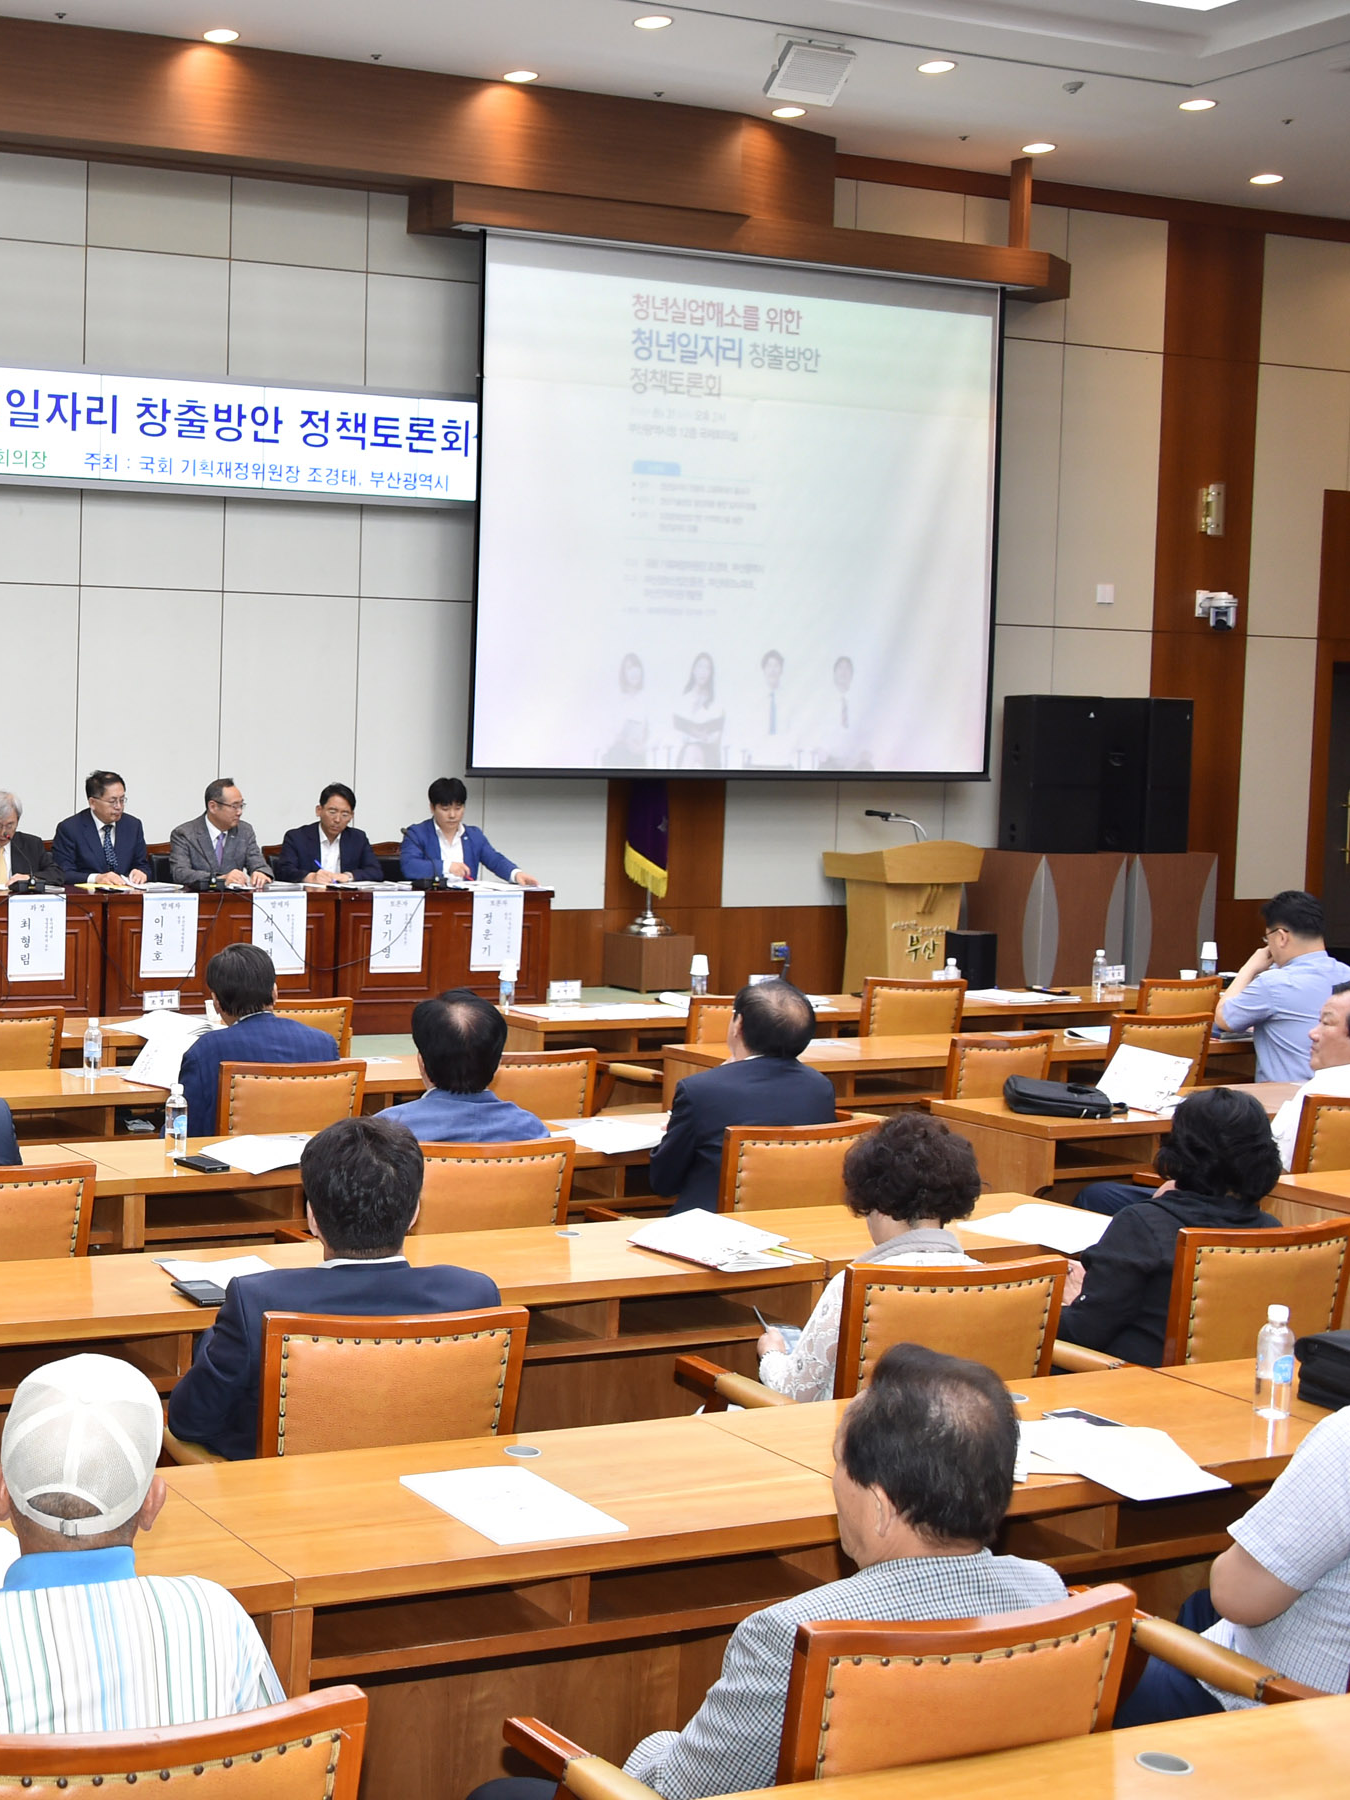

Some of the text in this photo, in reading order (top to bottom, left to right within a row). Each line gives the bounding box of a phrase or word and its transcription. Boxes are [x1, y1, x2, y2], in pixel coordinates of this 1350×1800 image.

[631, 293, 803, 336] 청년실업해소를 위한
[631, 327, 821, 374] 청년일자리 창출방안
[630, 367, 723, 399] 정책토론회
[136, 397, 283, 444] 창출방안
[299, 408, 470, 457] 정책토론회
[84, 453, 119, 472] 주최
[139, 456, 173, 476] 국회
[181, 459, 301, 484] 기획재정위원장
[369, 471, 449, 492] 부산광역시
[20, 917, 31, 966] 최형림
[152, 915, 164, 962] 이철호
[906, 933, 940, 963] 부산
